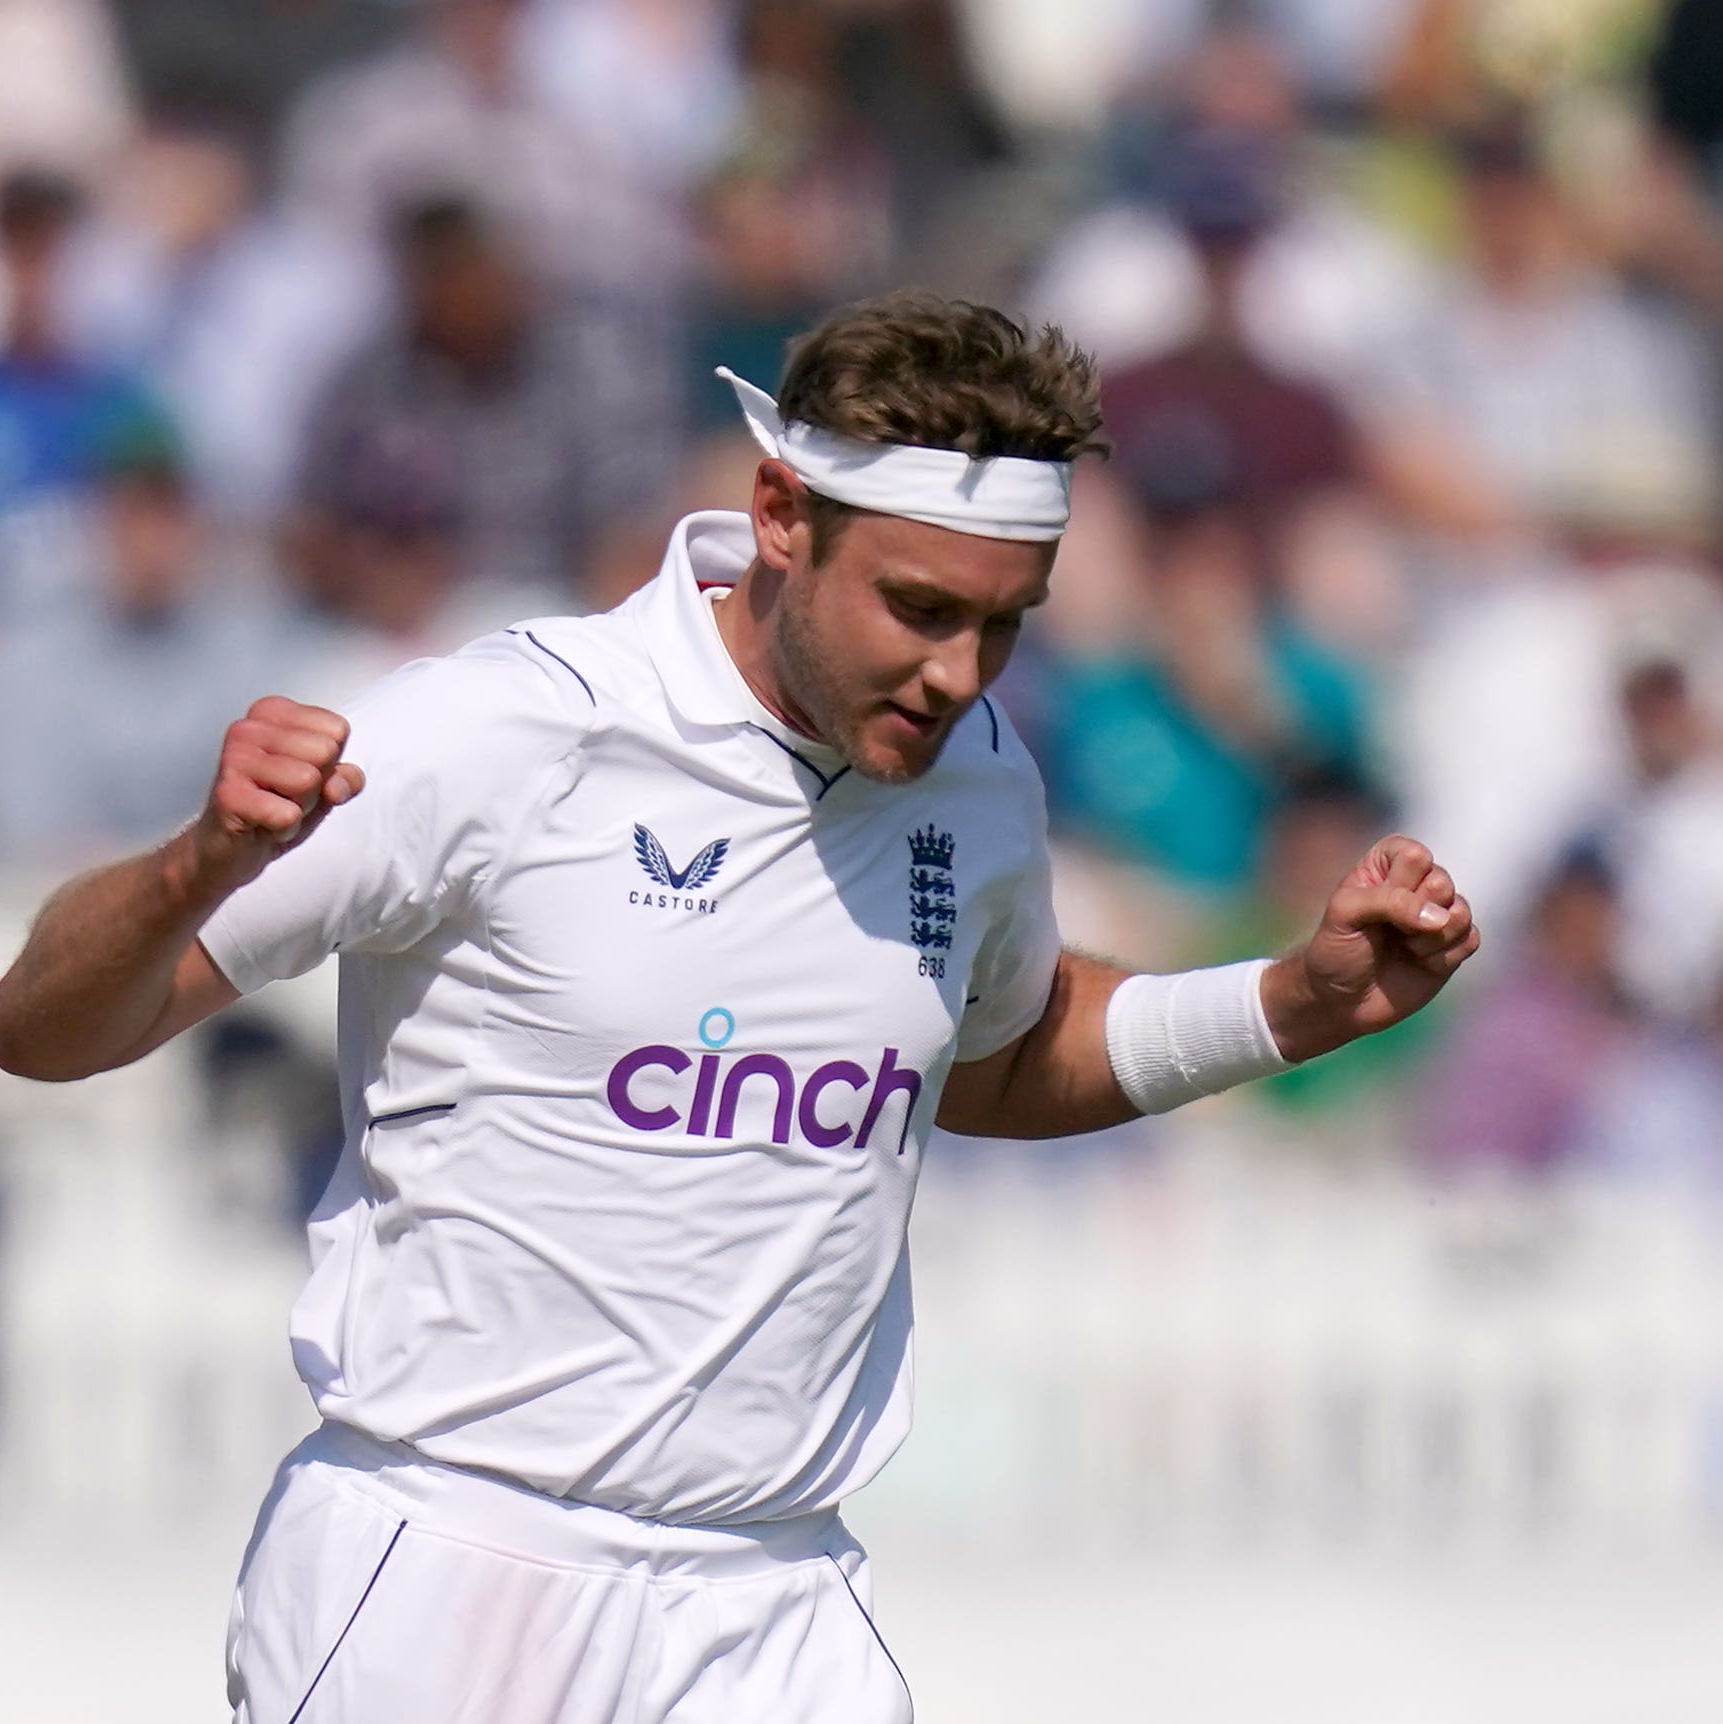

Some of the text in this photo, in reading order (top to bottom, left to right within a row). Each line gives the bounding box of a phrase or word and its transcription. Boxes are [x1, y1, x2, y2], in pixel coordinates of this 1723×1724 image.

[628, 890, 719, 915] CASTORE
[917, 955, 947, 979] 638
[606, 1007, 923, 1156] cinch
